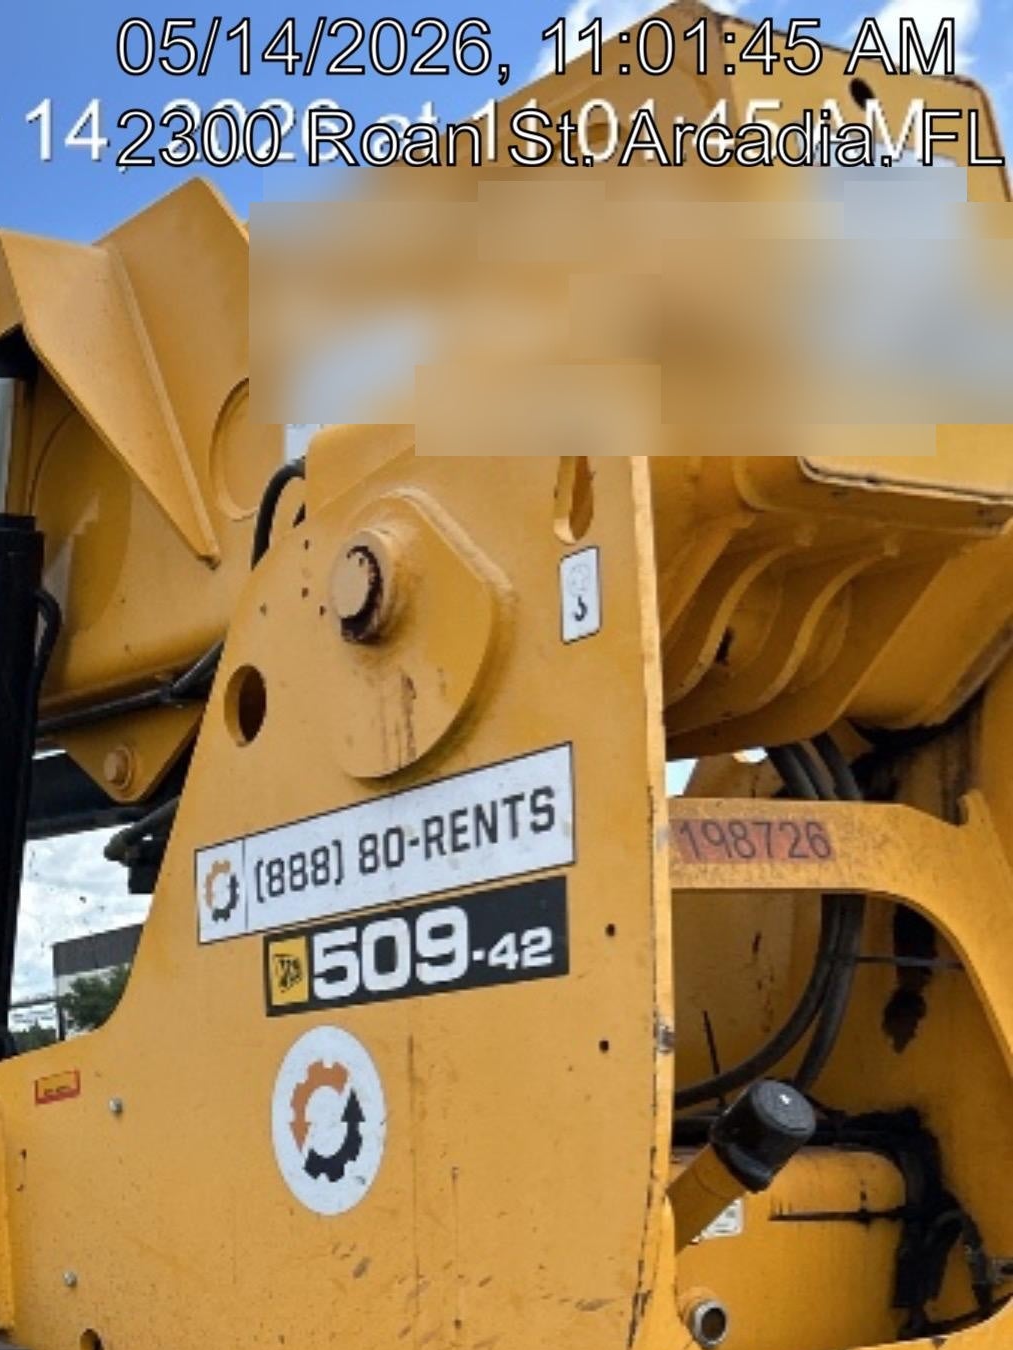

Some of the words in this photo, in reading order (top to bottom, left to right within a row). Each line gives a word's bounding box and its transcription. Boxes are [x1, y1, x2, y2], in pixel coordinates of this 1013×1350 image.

[255, 839, 344, 903] (888)
[358, 786, 555, 875] 80-RENTS
[679, 820, 832, 860] 198726
[312, 906, 553, 1000] 509-42
